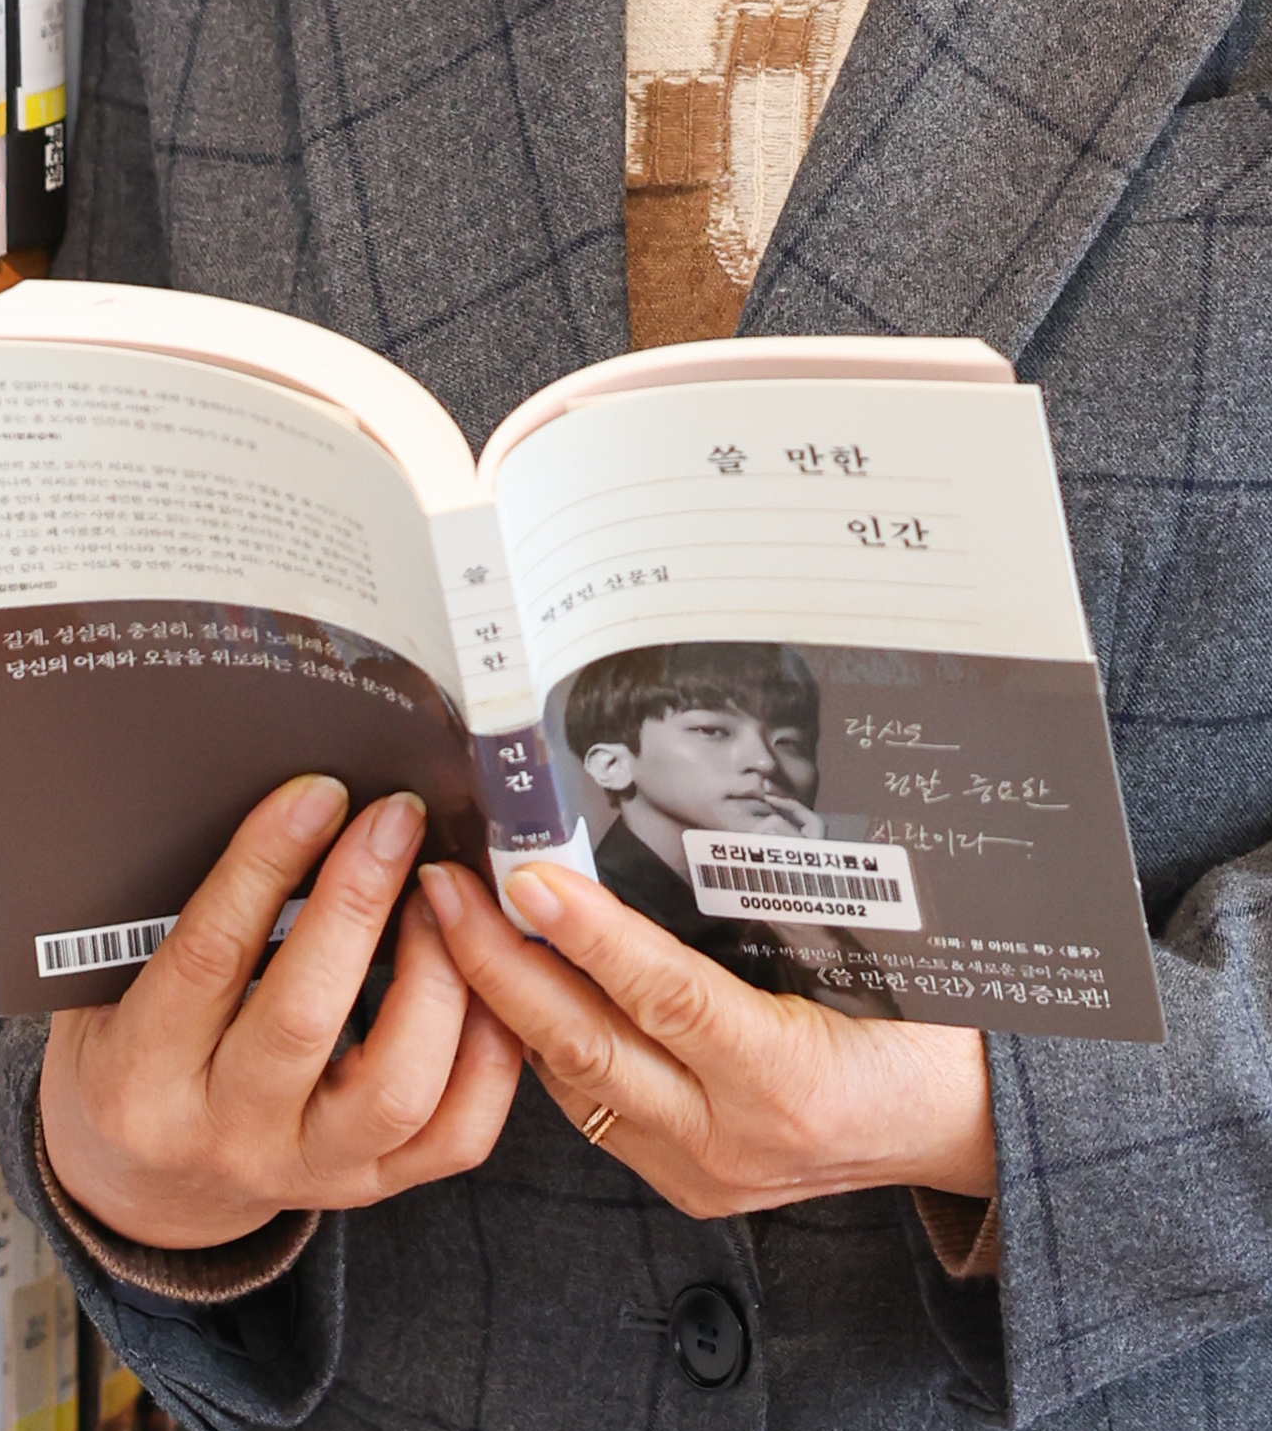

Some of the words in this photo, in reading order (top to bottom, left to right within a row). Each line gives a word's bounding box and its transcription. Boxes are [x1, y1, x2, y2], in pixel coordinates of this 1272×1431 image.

[707, 443, 747, 475] 쓸
[783, 442, 870, 477] 만한
[846, 515, 930, 551] 인간
[540, 582, 595, 623] 박정민
[603, 564, 670, 592] 산문집
[52, 622, 123, 646] 성실히,
[5, 654, 68, 680] 당신의
[73, 649, 137, 672] 어제와
[142, 648, 206, 668] 오늘을
[210, 649, 293, 673] 위로하는
[497, 741, 534, 793] 인간
[709, 842, 879, 872] 전라남도의회자료실
[740, 894, 868, 918] 000000043082
[951, 959, 965, 972] &
[968, 958, 1015, 976] 새로운
[860, 970, 910, 993] 만한
[980, 980, 1112, 1010] 개정증보판!
